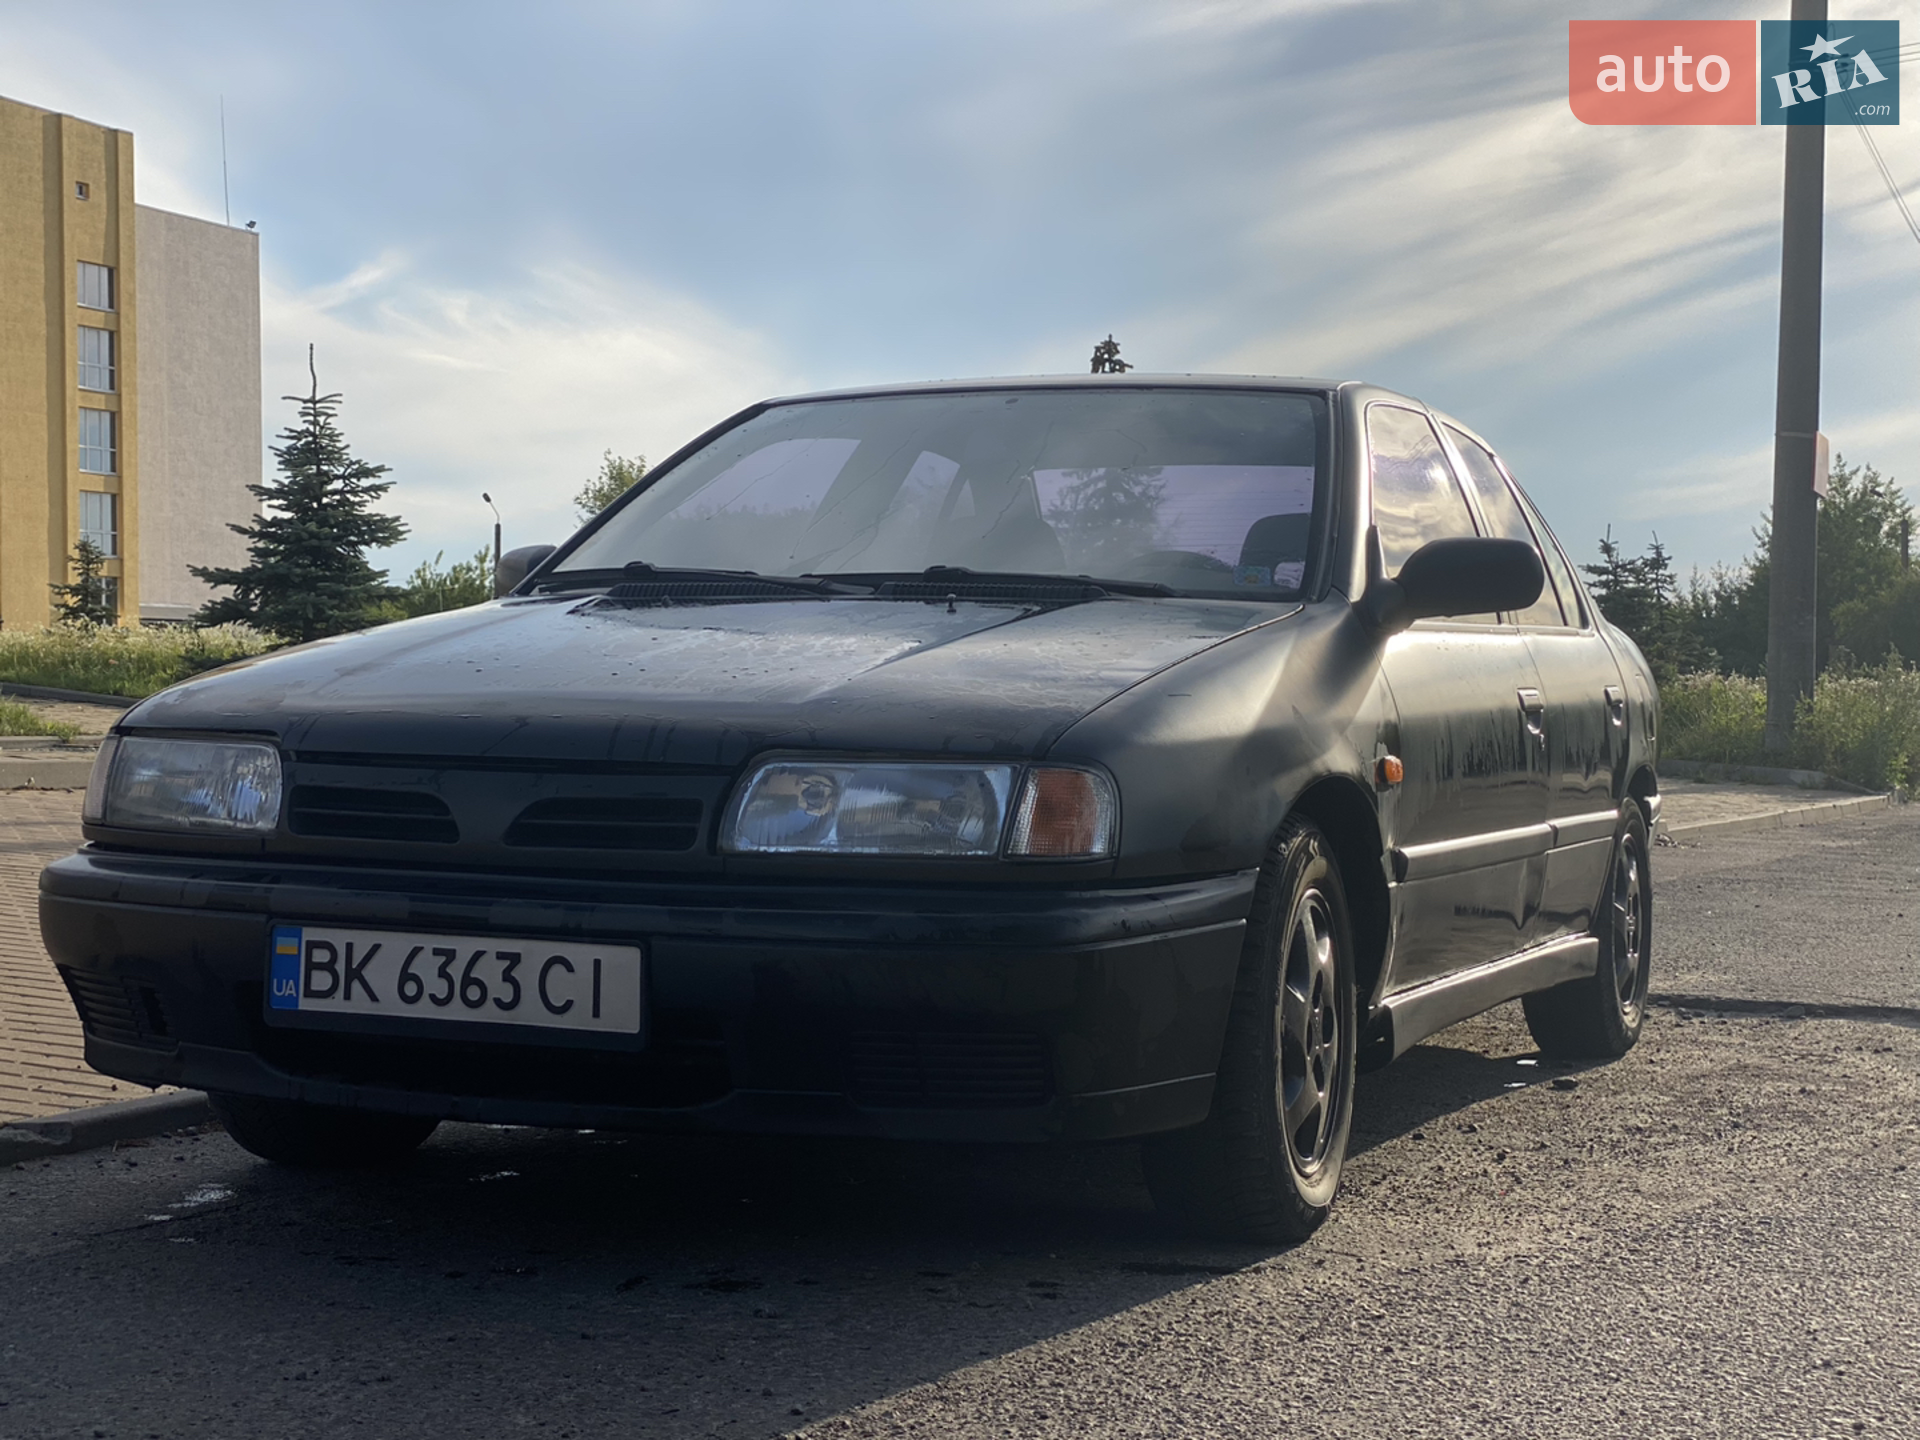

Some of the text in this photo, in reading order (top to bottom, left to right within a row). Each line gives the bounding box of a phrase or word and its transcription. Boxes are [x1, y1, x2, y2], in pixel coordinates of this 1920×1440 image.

[272, 978, 297, 998] UA
[303, 939, 602, 1019] BK 6363 CI
